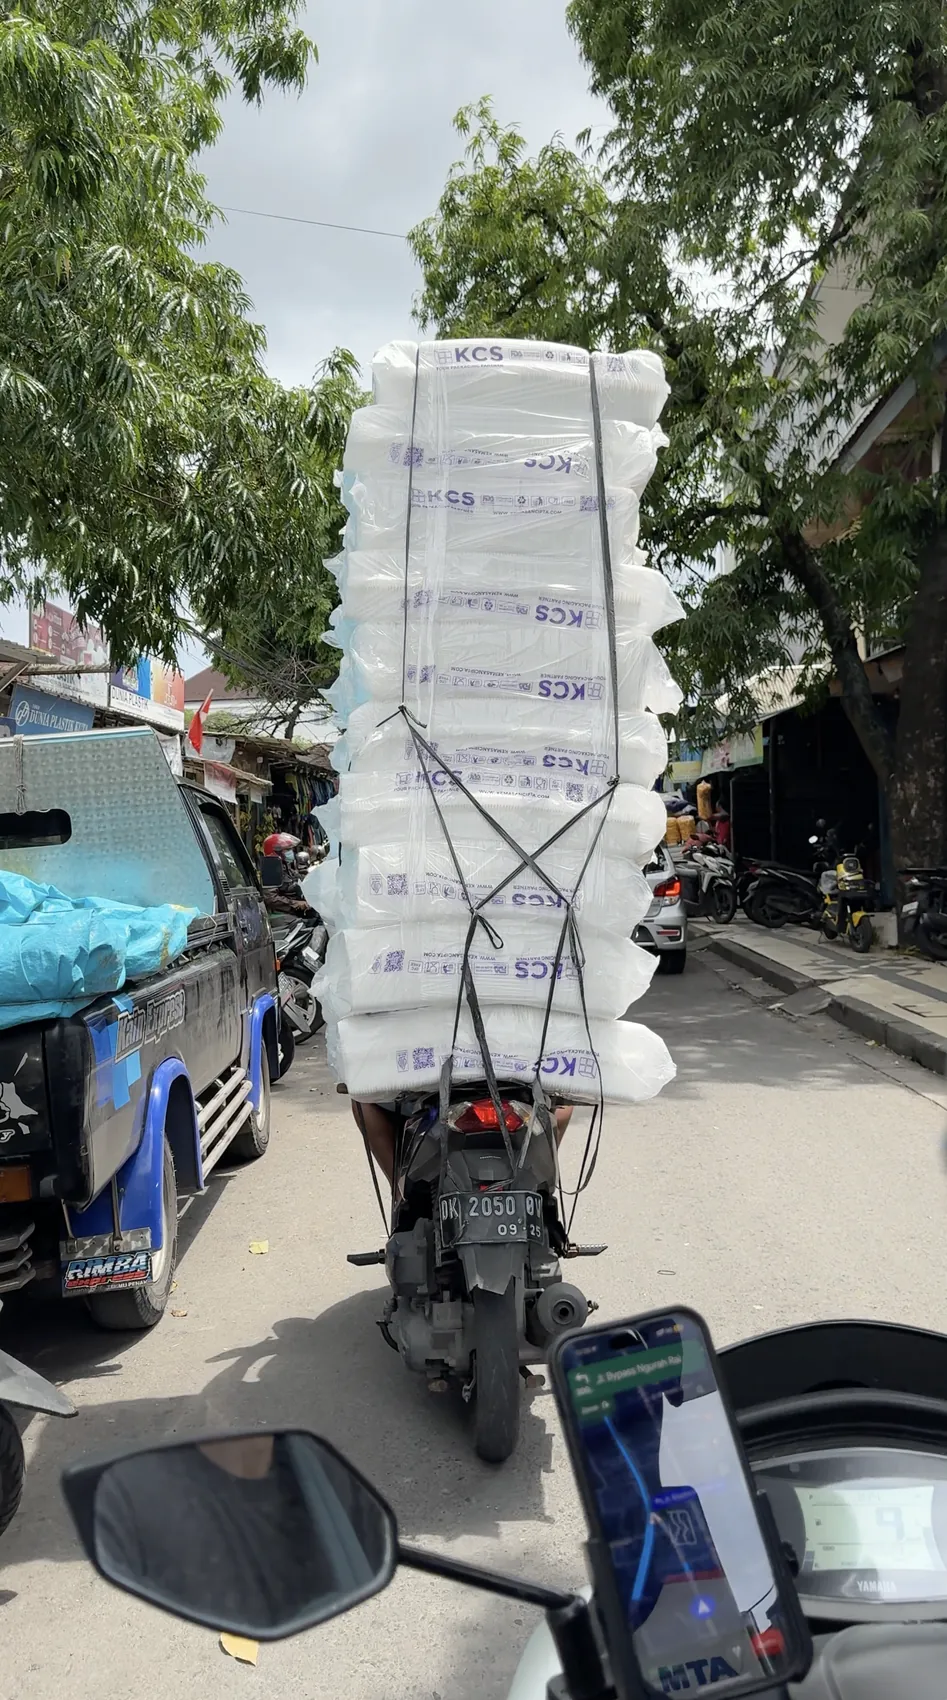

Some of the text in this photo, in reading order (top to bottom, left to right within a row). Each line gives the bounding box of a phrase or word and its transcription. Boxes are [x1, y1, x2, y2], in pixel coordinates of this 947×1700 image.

[455, 346, 503, 362] KCS
[427, 489, 475, 506] KCS
[535, 605, 584, 628] KCS
[112, 686, 128, 701] DUNIA
[538, 680, 585, 701] KCS
[29, 710, 50, 727] DUNIA
[49, 713, 75, 731] PLASTIK
[543, 755, 589, 776] KCS
[512, 893, 562, 908] KCS
[514, 961, 563, 980] KCS
[441, 1197, 459, 1221] DK
[468, 1196, 516, 1217] 2050
[497, 1224, 541, 1238] 09 25
[66, 1252, 150, 1280] RIMBA
[606, 1366, 637, 1381] Bypass
[636, 1359, 668, 1375] Ngurah
[667, 1354, 682, 1366] Rai
[857, 1580, 897, 1592] YAMAHA
